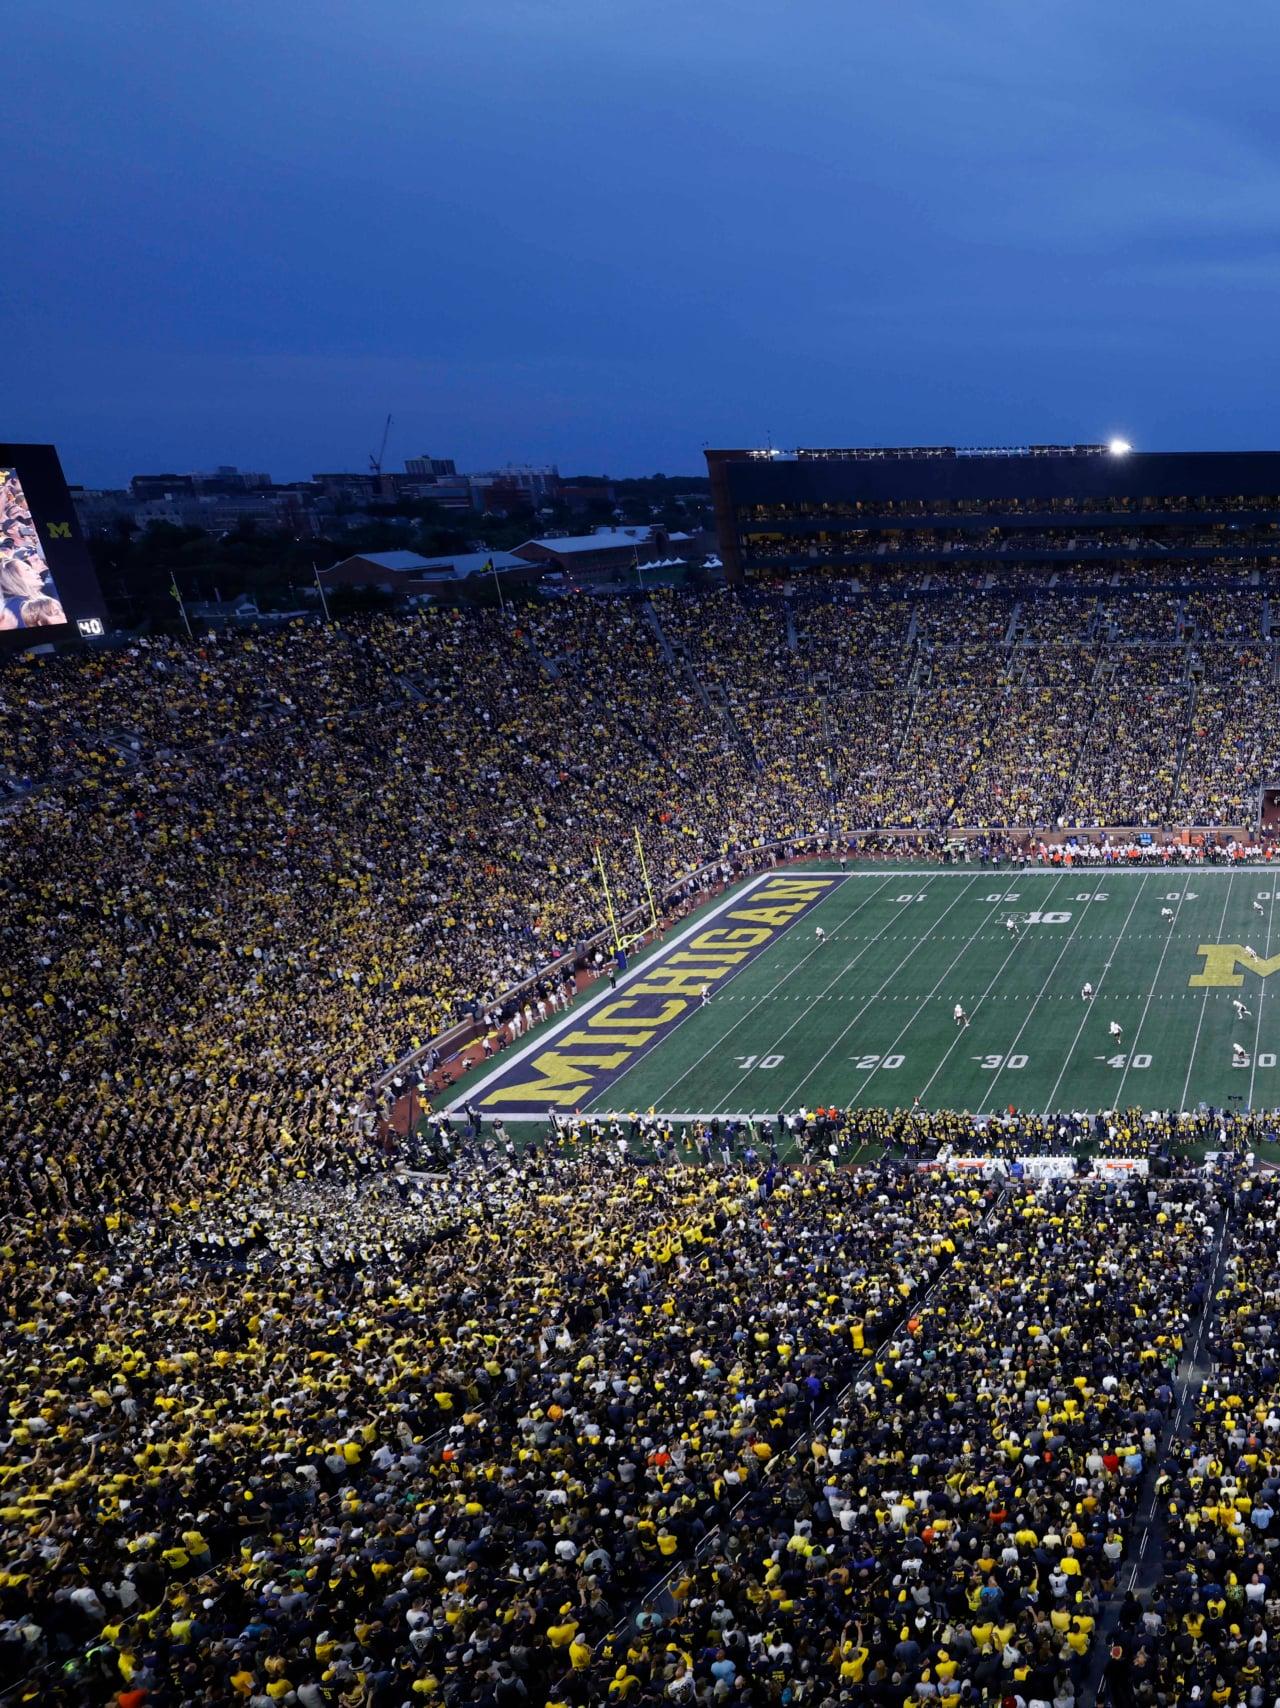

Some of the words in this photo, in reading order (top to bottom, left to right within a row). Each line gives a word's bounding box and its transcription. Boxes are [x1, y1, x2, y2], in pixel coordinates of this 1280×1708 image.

[46, 522, 72, 538] M
[79, 620, 101, 634] 40
[478, 879, 834, 1106] MICHIGAN
[738, 1055, 785, 1069] 10
[855, 1055, 906, 1069] 20
[981, 1054, 1029, 1068] 30
[1107, 1054, 1152, 1068] 40
